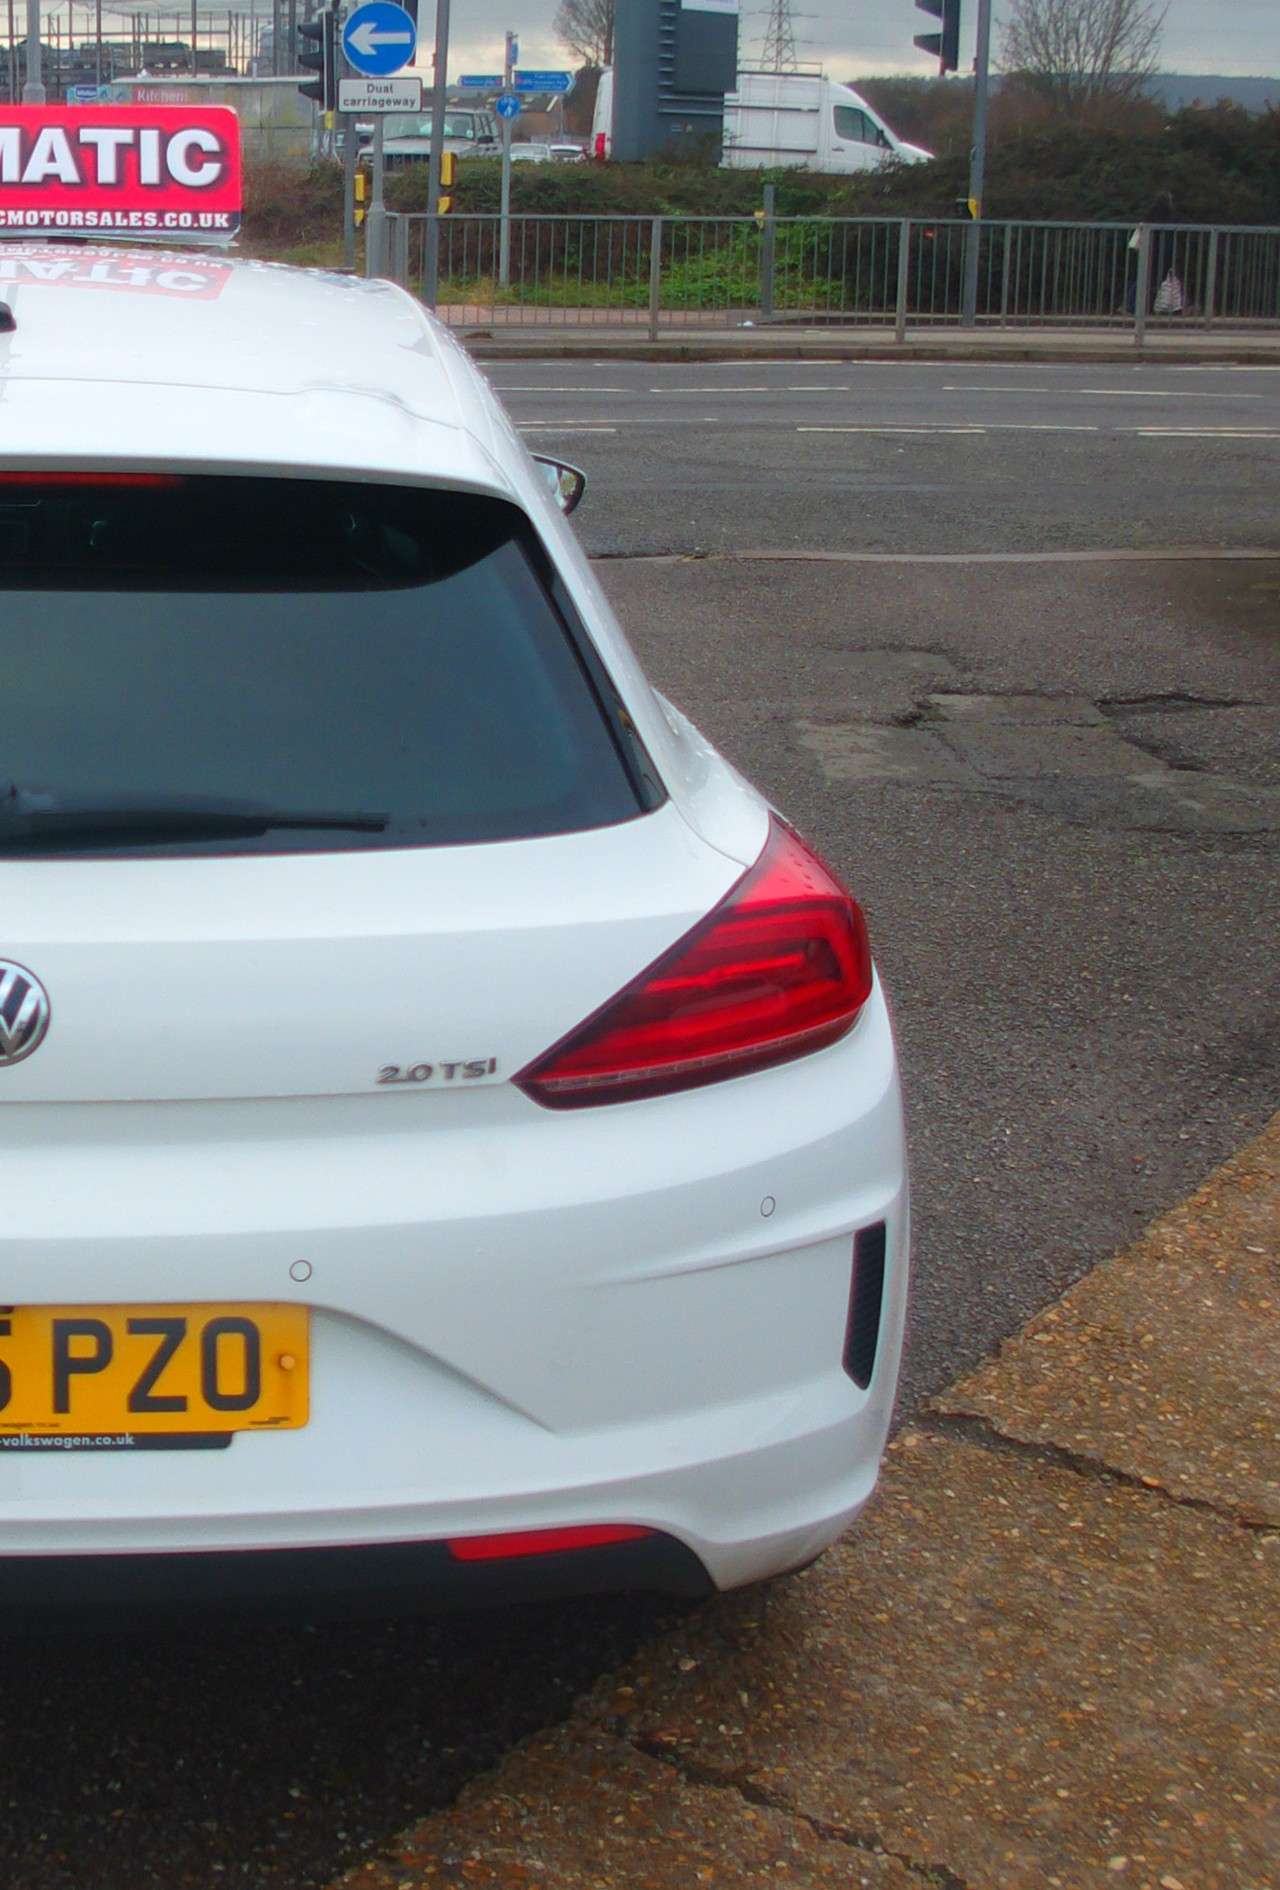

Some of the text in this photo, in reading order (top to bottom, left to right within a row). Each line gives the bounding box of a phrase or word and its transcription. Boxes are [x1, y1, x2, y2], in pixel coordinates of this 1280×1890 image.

[366, 82, 394, 94] Dual
[343, 97, 416, 109] carriageway
[438, 1056, 497, 1080] TSI
[52, 1317, 262, 1414] PZO
